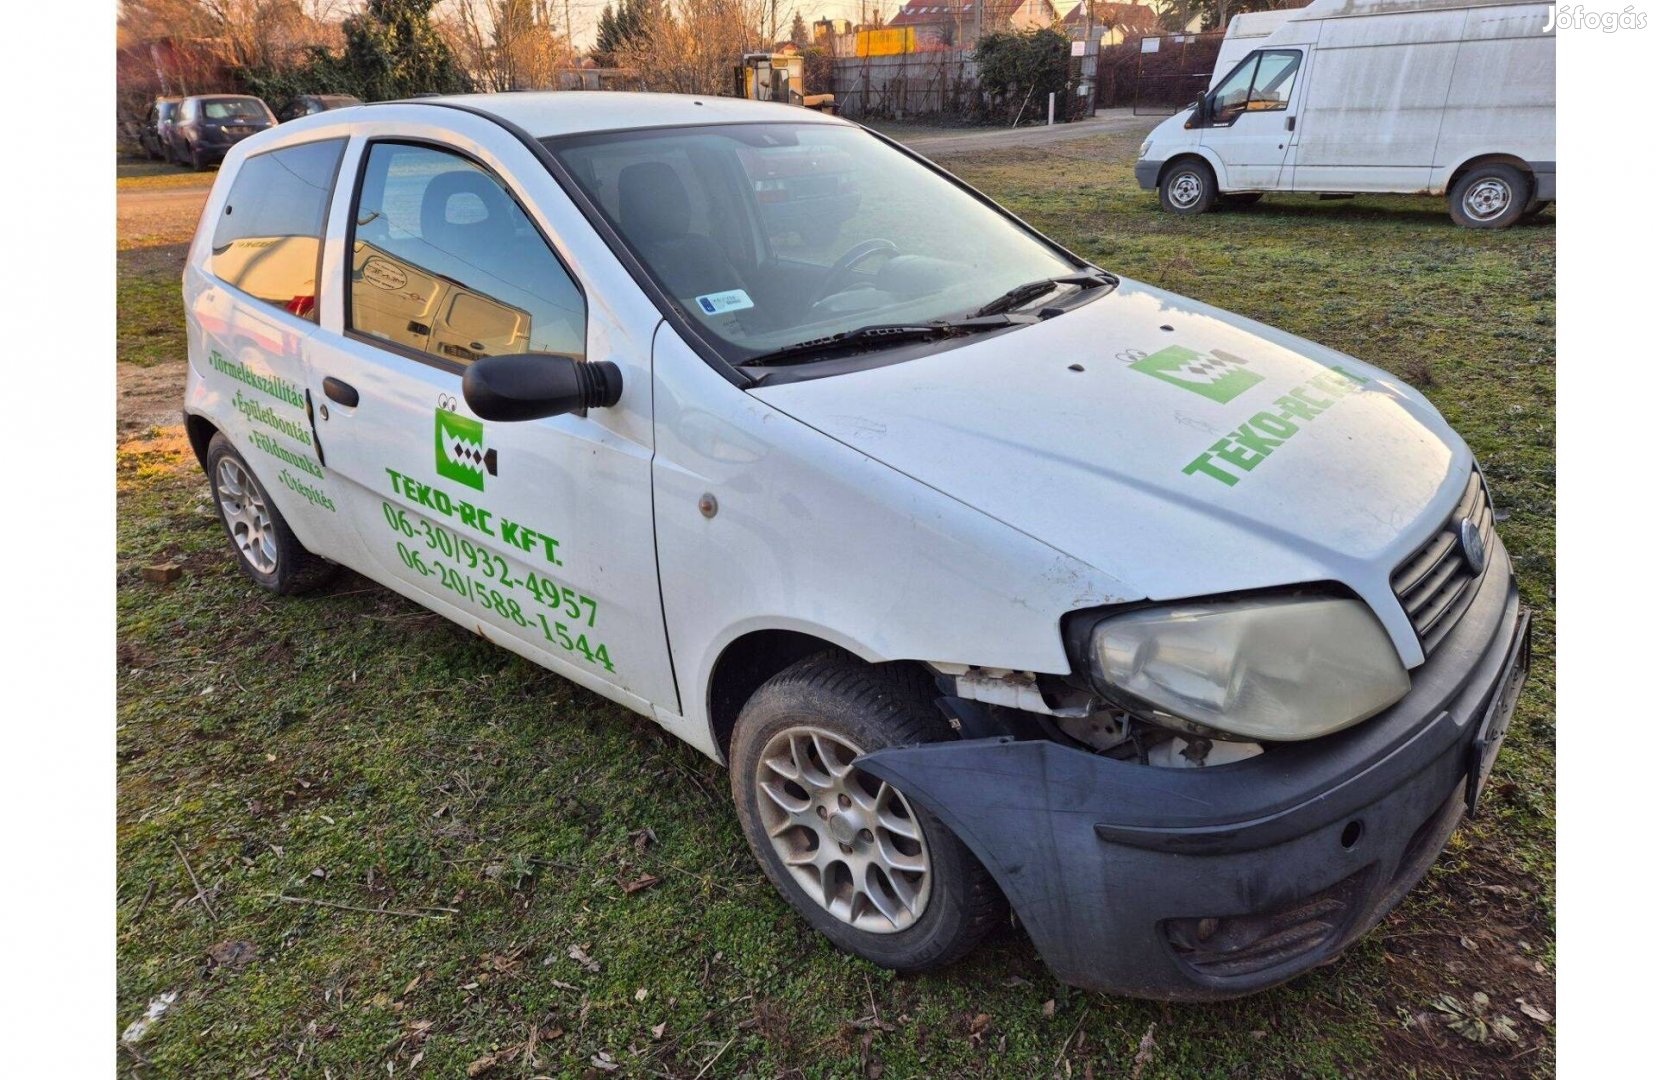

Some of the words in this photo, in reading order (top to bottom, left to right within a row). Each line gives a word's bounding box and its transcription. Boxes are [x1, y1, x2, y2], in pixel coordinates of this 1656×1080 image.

[1181, 386, 1335, 487] TEKO-RC
[382, 502, 598, 628] 06-30/932-4957
[385, 467, 496, 537] TEKO-RC
[500, 517, 563, 567] KFT.
[396, 541, 617, 674] 06-20/588-1544
